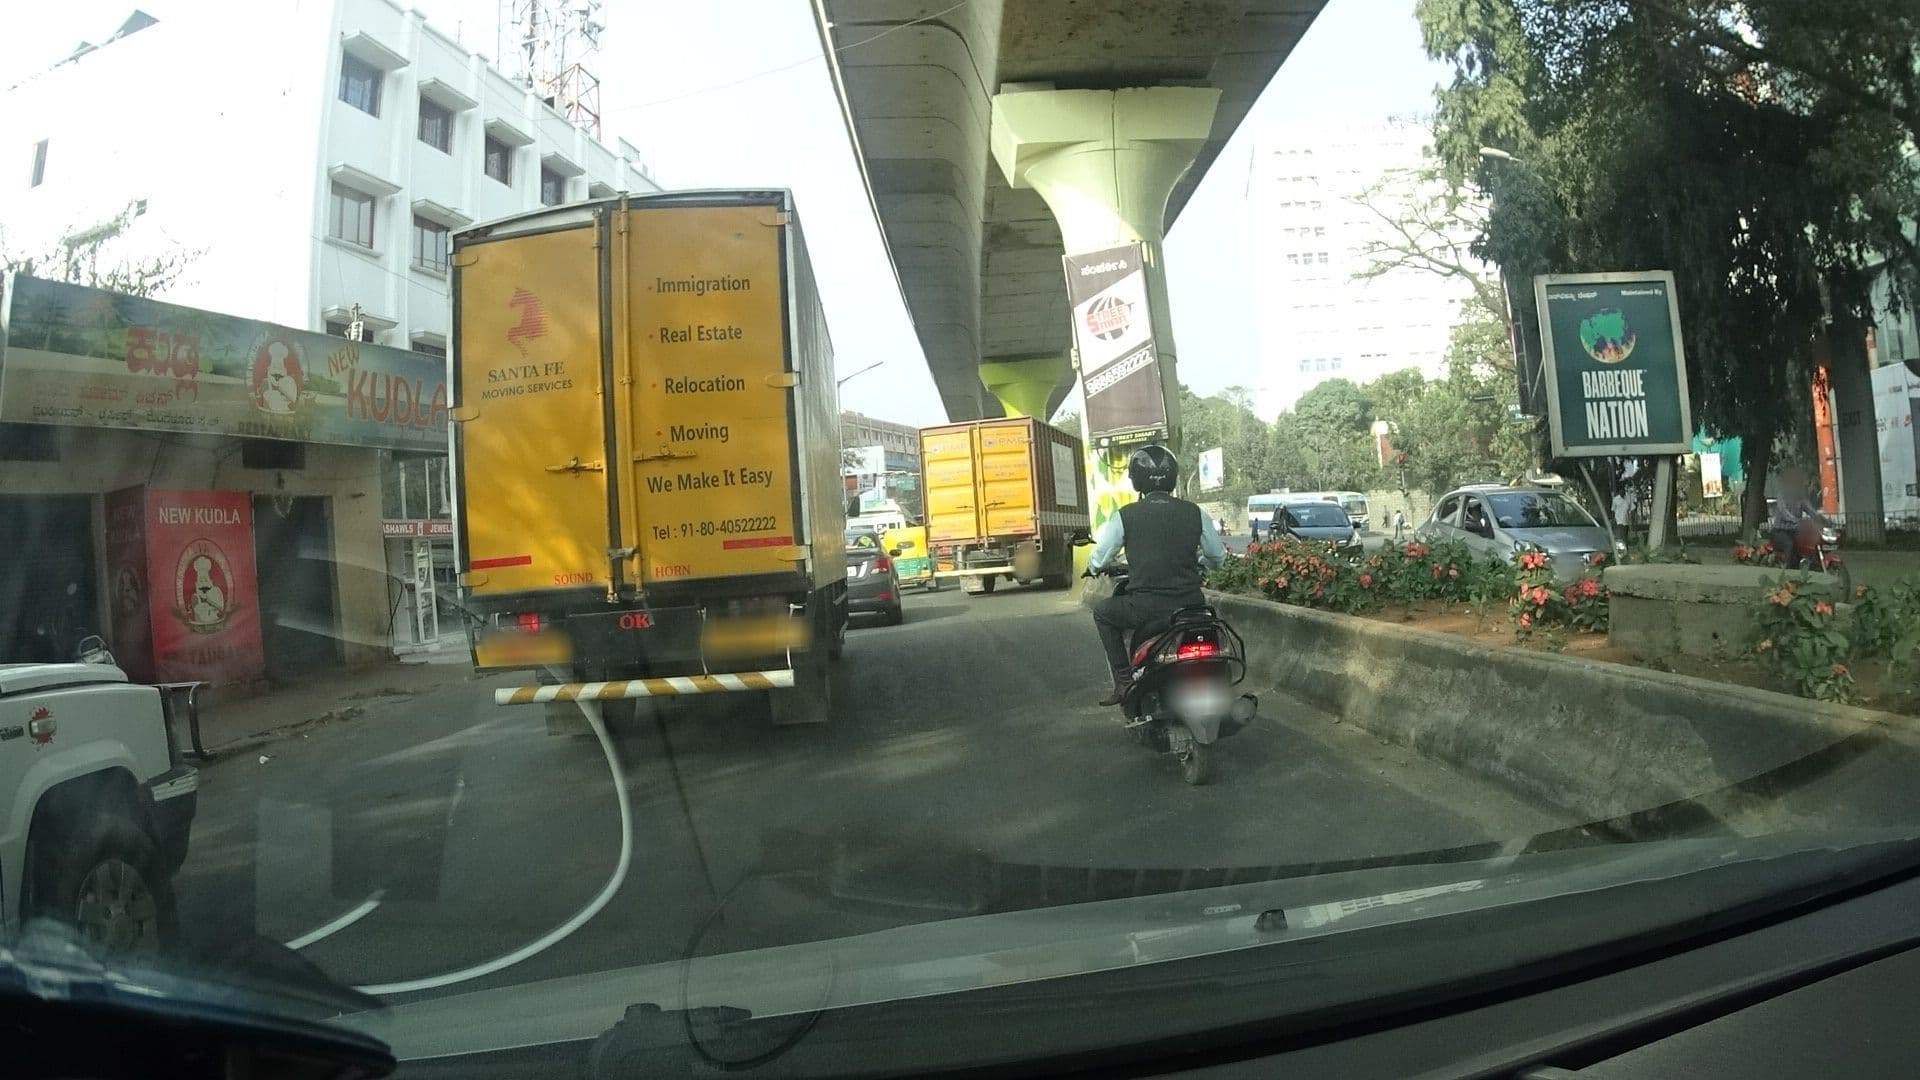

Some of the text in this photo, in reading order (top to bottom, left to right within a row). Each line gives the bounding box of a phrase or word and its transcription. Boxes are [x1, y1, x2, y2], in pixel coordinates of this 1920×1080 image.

[656, 274, 751, 296] Immigration
[660, 325, 742, 344] Real Estate
[327, 342, 361, 377] NEW
[488, 363, 565, 382] SANTA FE
[481, 378, 573, 400] MOVING SERVICES
[664, 374, 746, 394] Relocation
[1581, 369, 1645, 399] BARBEQUE
[346, 367, 448, 427] KUDLA
[1585, 400, 1648, 439] NATION
[670, 426, 729, 442] Moving
[646, 469, 773, 494] We Make It Easy
[159, 508, 191, 523] NEW
[195, 508, 241, 524] KUDLA
[653, 525, 670, 540] Tel
[681, 516, 777, 535] 91-80-40522222
[553, 573, 594, 585] SOUND
[655, 565, 690, 578] HORN
[619, 614, 649, 630] OK
